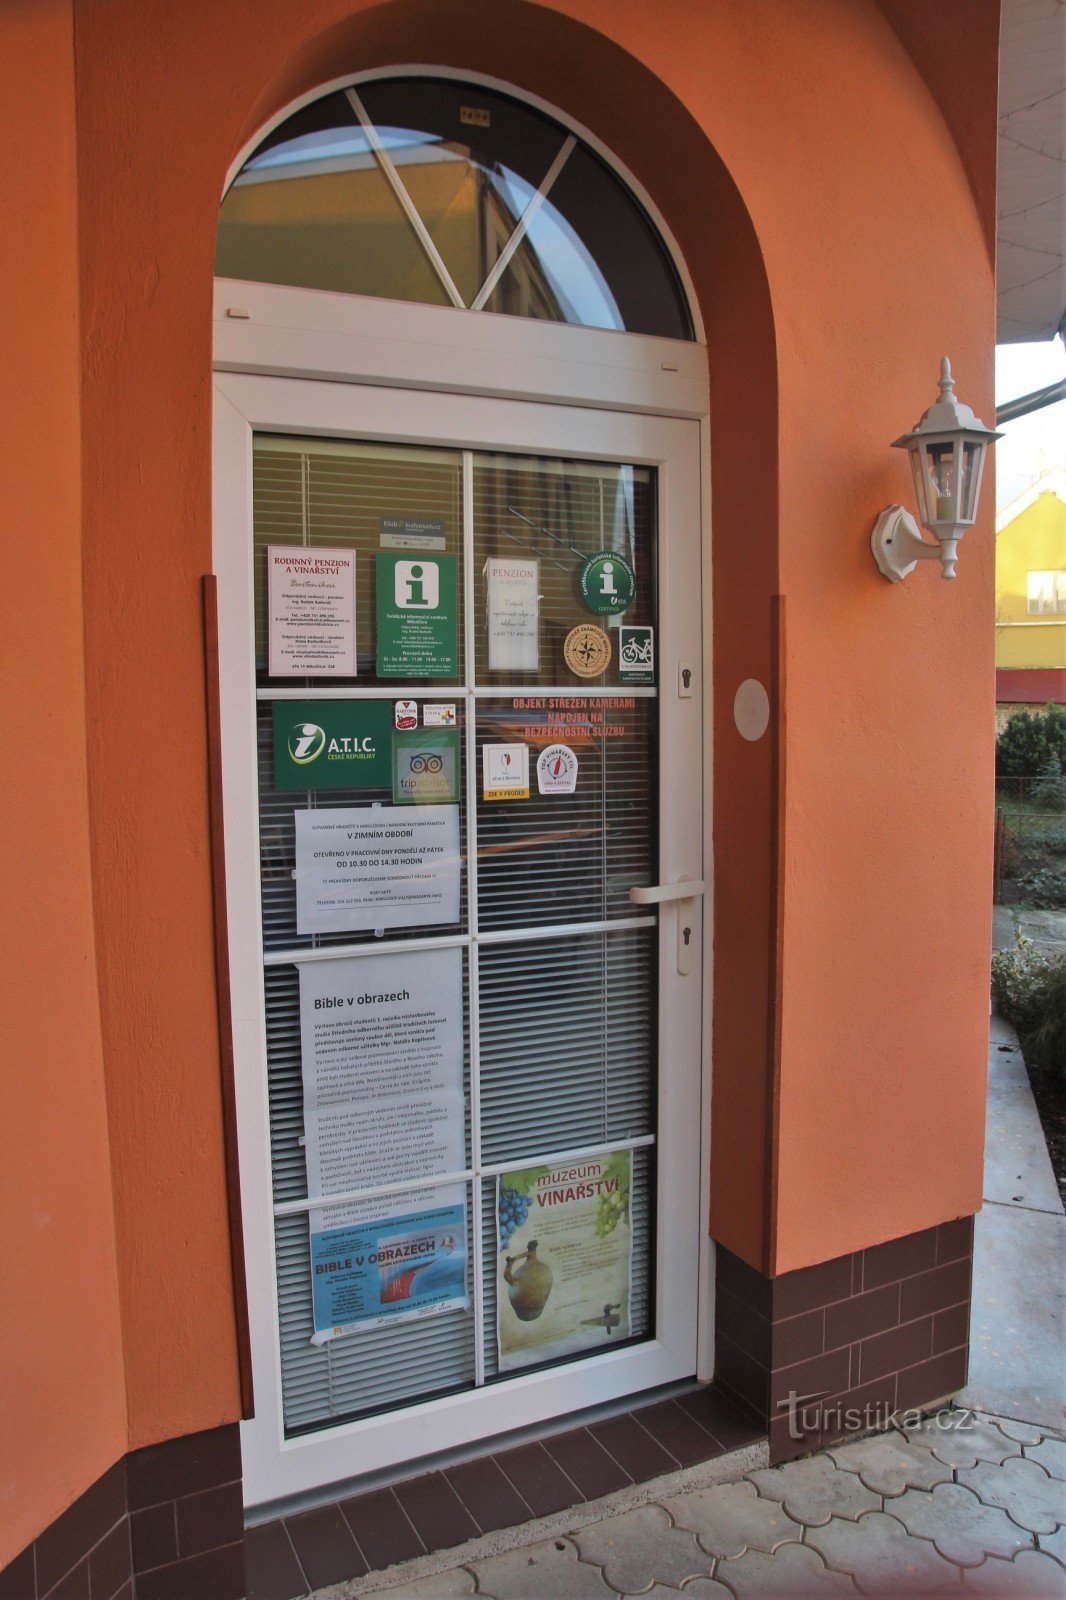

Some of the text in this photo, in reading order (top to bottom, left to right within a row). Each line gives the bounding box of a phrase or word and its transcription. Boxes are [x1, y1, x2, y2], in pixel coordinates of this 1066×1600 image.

[274, 558, 312, 566] RODINNÝ
[294, 567, 340, 575] VINAŘSTVÍ
[493, 569, 534, 578] PENZION
[513, 697, 635, 709] OBJEKT STŘEŽEN KAMERAMI
[548, 713, 603, 723] NAPOJEN NA
[328, 738, 376, 753] A.T.I.C.
[400, 779, 450, 789] tripadvisor
[354, 831, 384, 839] ZIMNÍM
[385, 829, 413, 838] OBDOBÍ
[314, 990, 410, 1010] Bible v obrazech
[537, 1163, 601, 1186] muzeum
[537, 1176, 620, 1208] VINAŘSTVÍ
[316, 1258, 353, 1275] BIBLE
[356, 1256, 364, 1266] V
[368, 1241, 436, 1264] OBRAZECH
